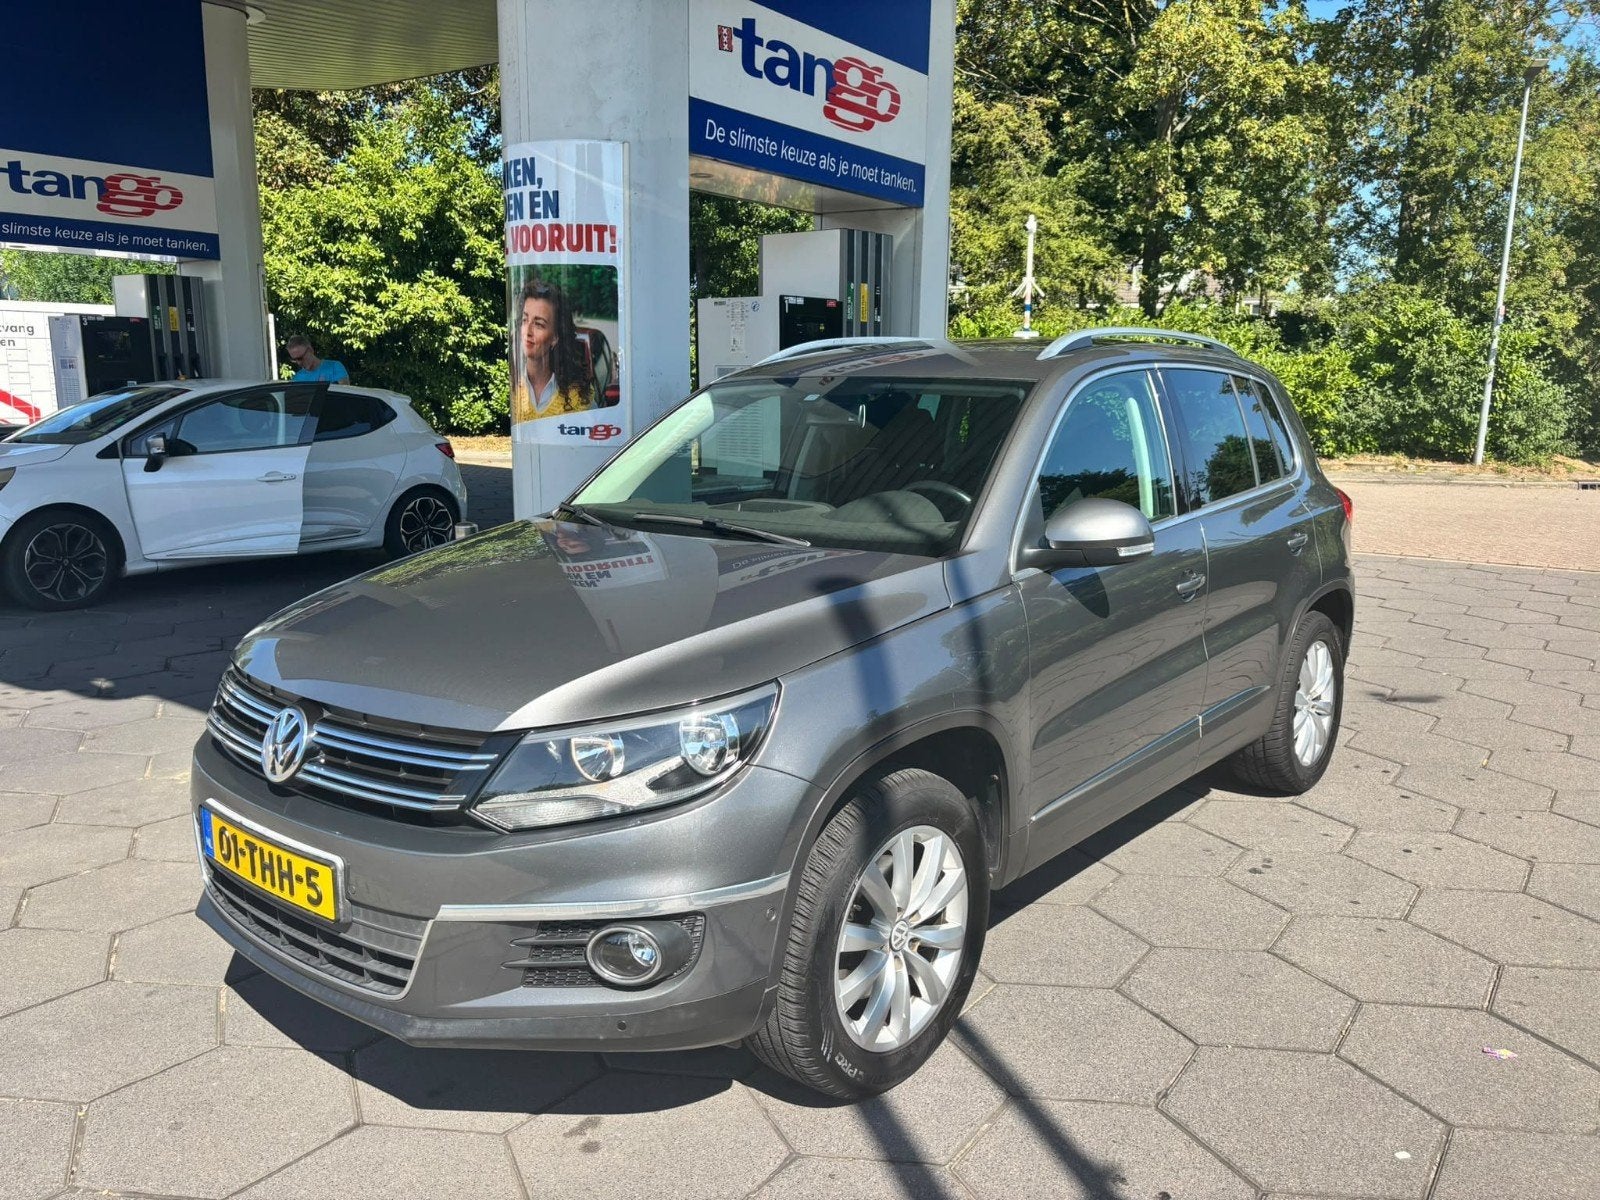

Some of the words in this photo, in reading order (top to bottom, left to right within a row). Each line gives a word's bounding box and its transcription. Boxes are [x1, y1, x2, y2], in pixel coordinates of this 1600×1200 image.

[733, 18, 901, 132] tango
[705, 118, 726, 143] De
[729, 128, 777, 157] slimste
[781, 140, 816, 167] keuze
[819, 153, 836, 172] als
[837, 155, 849, 177] je
[851, 164, 879, 182] moet
[880, 170, 916, 193] tanken.
[0, 160, 184, 218] tango
[503, 157, 543, 190] KEN,
[529, 190, 560, 220] EN
[1, 222, 51, 238] slimste
[55, 226, 93, 241] keuze
[96, 230, 115, 243] als
[117, 233, 129, 246] je
[132, 234, 162, 248] moet
[166, 238, 210, 252] tanken.
[511, 223, 617, 254] VOORUIT!
[557, 423, 622, 441] tango
[218, 825, 323, 908] 01-THH-5
